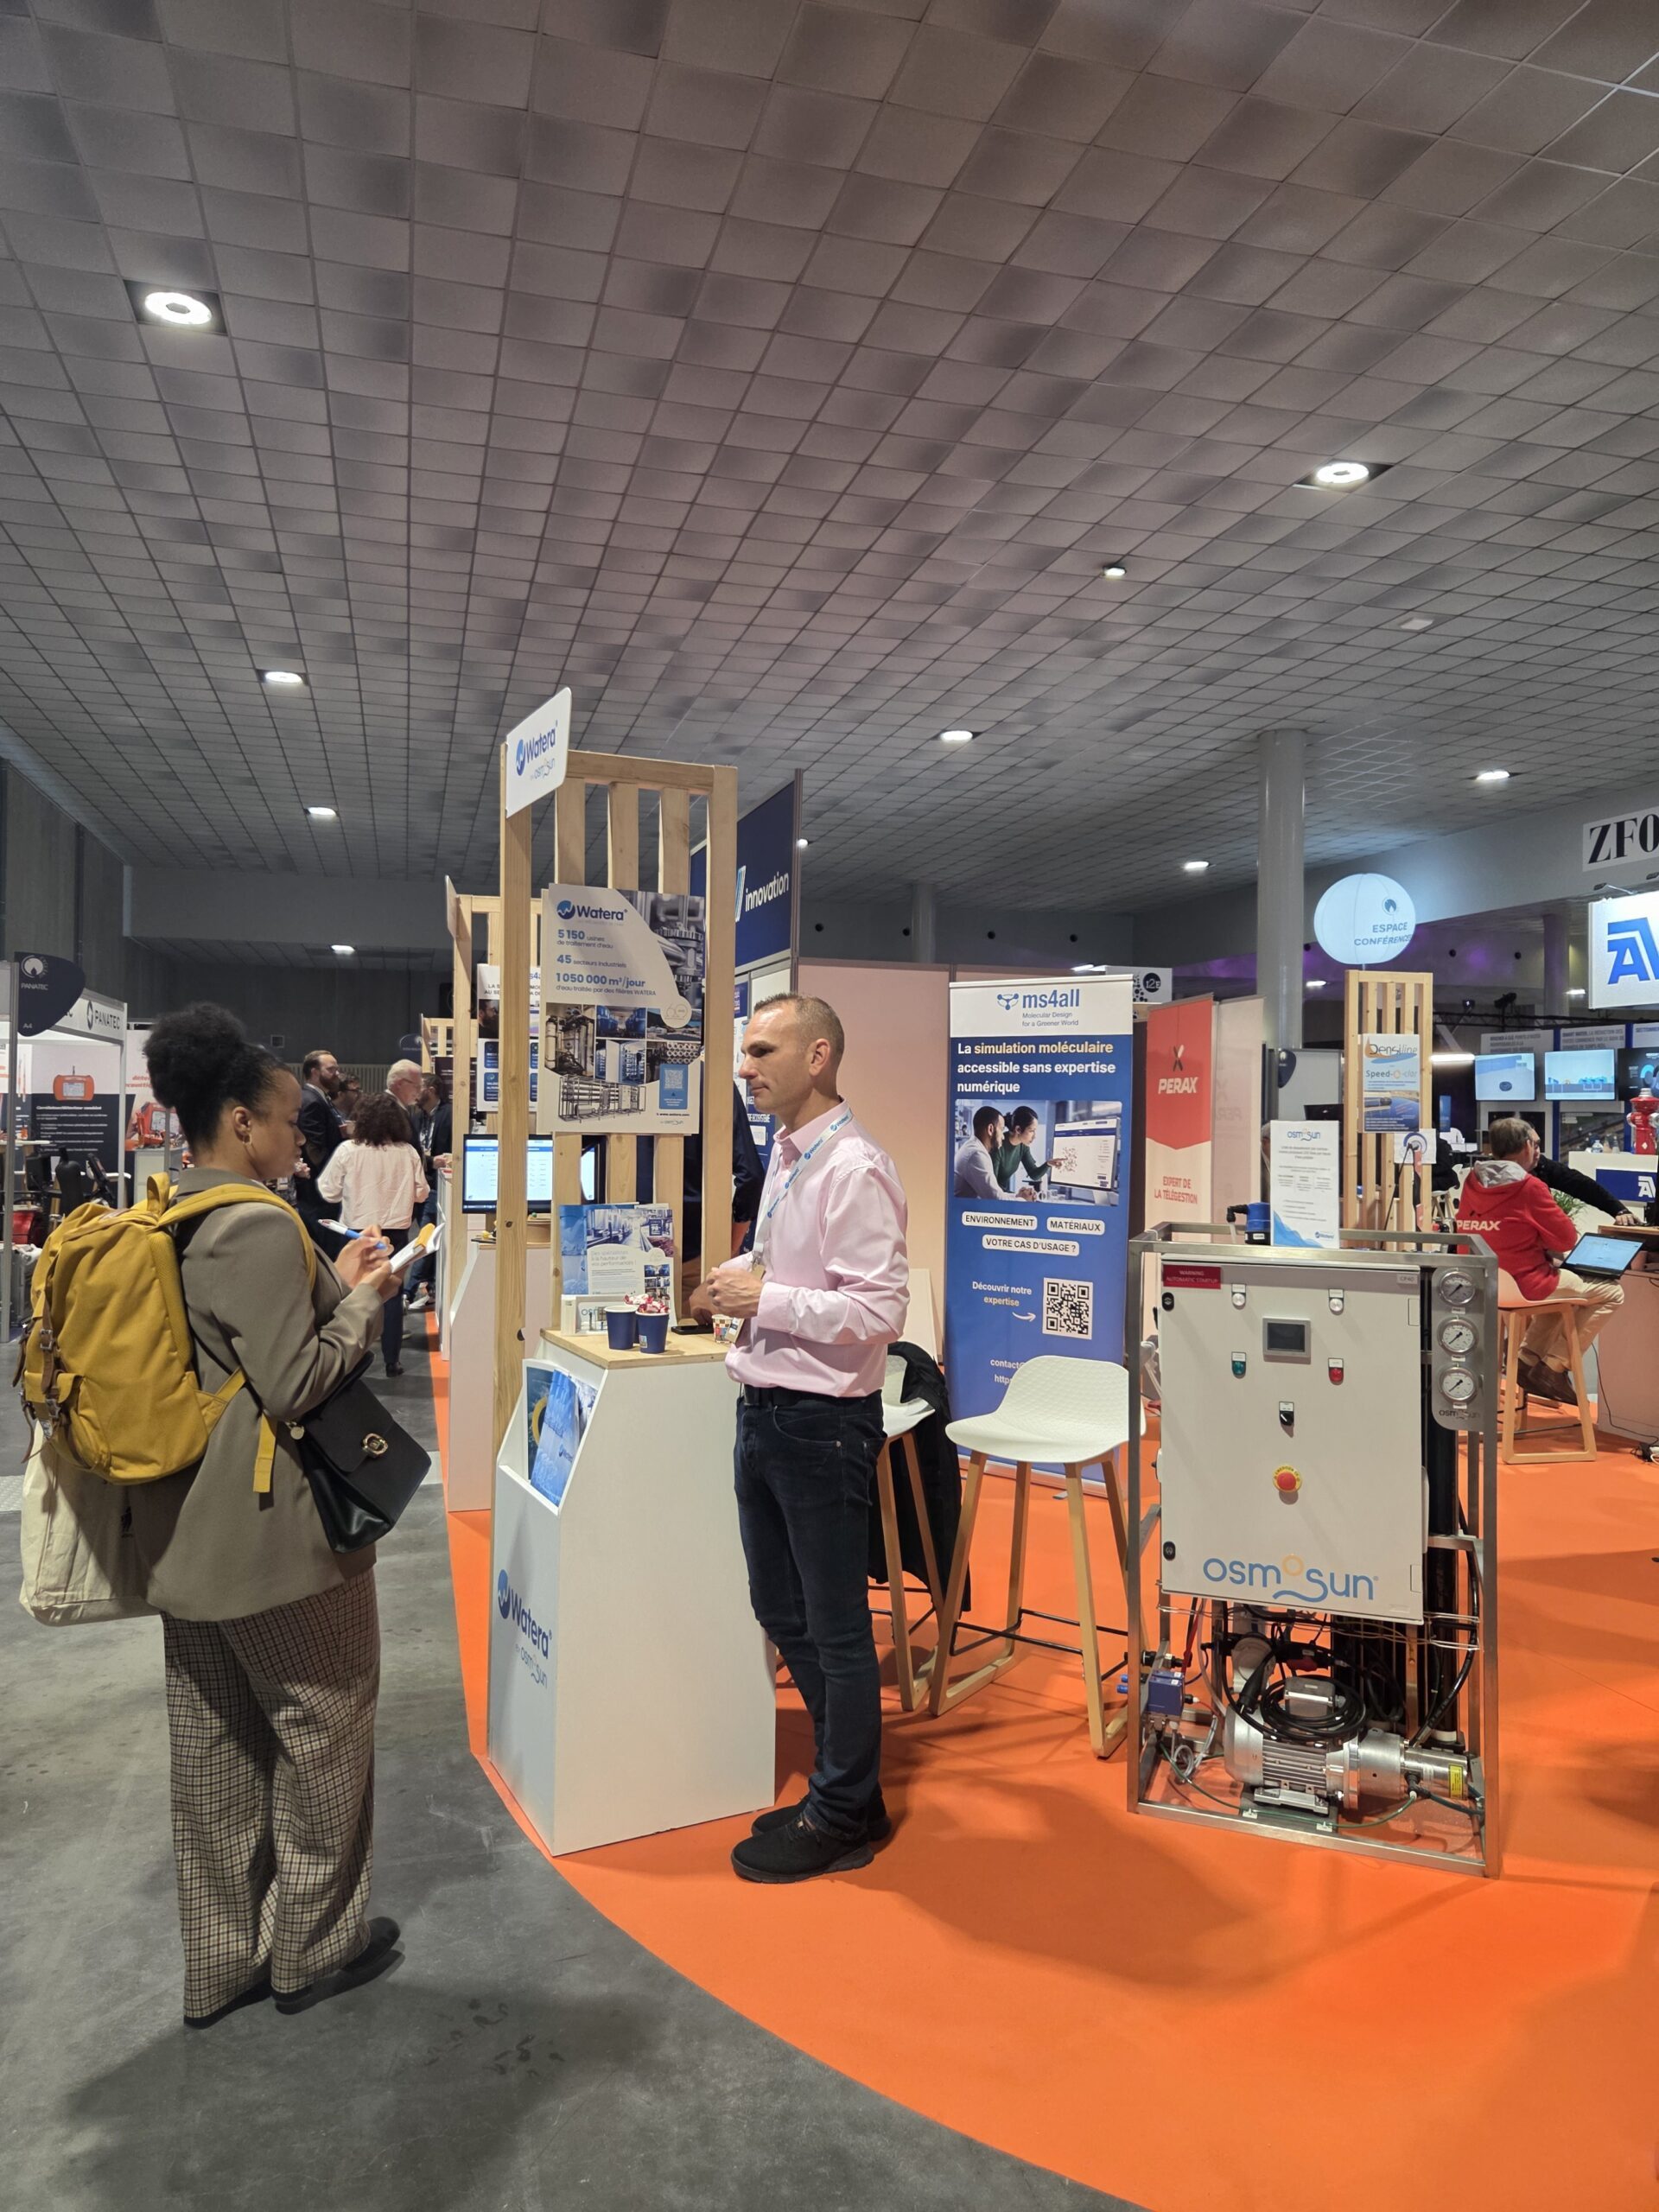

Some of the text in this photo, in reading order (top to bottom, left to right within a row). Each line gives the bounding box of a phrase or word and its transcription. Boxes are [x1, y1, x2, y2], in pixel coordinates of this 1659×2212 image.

[526, 728, 556, 764] Watera
[745, 871, 789, 912] innovation
[576, 905, 625, 921] Watera
[1372, 922, 1408, 933] ESPACE
[566, 930, 585, 939] 150
[556, 955, 572, 964] 45
[598, 959, 627, 968] industriels
[21, 982, 49, 991] PANATEC
[586, 975, 607, 985] 000
[1022, 988, 1080, 1009] ms4all
[95, 1009, 121, 1030] PANATEC
[957, 1041, 1114, 1054] La simulation moléculaire
[1369, 1044, 1418, 1055] Densiline
[957, 1061, 1116, 1076] accessible sans expertise
[957, 1080, 1020, 1095] numérique
[1158, 1077, 1198, 1095] PERAX
[1162, 1176, 1192, 1189] EXPERT DE
[1154, 1189, 1198, 1204] LA TÉLÉGESTION
[965, 1215, 1035, 1227] ENVIRONNEMENT
[1050, 1220, 1102, 1232] MATÉRIAUX
[1457, 1219, 1502, 1230] PERAX
[986, 1238, 1013, 1248] VOTRE
[1014, 1241, 1032, 1249] CAS
[1033, 1243, 1070, 1252] D'USAGE
[972, 1281, 1033, 1295] Découvrir notre
[983, 1296, 1020, 1307] expertise
[994, 1374, 1012, 1385] http
[512, 1588, 549, 1660] Watera
